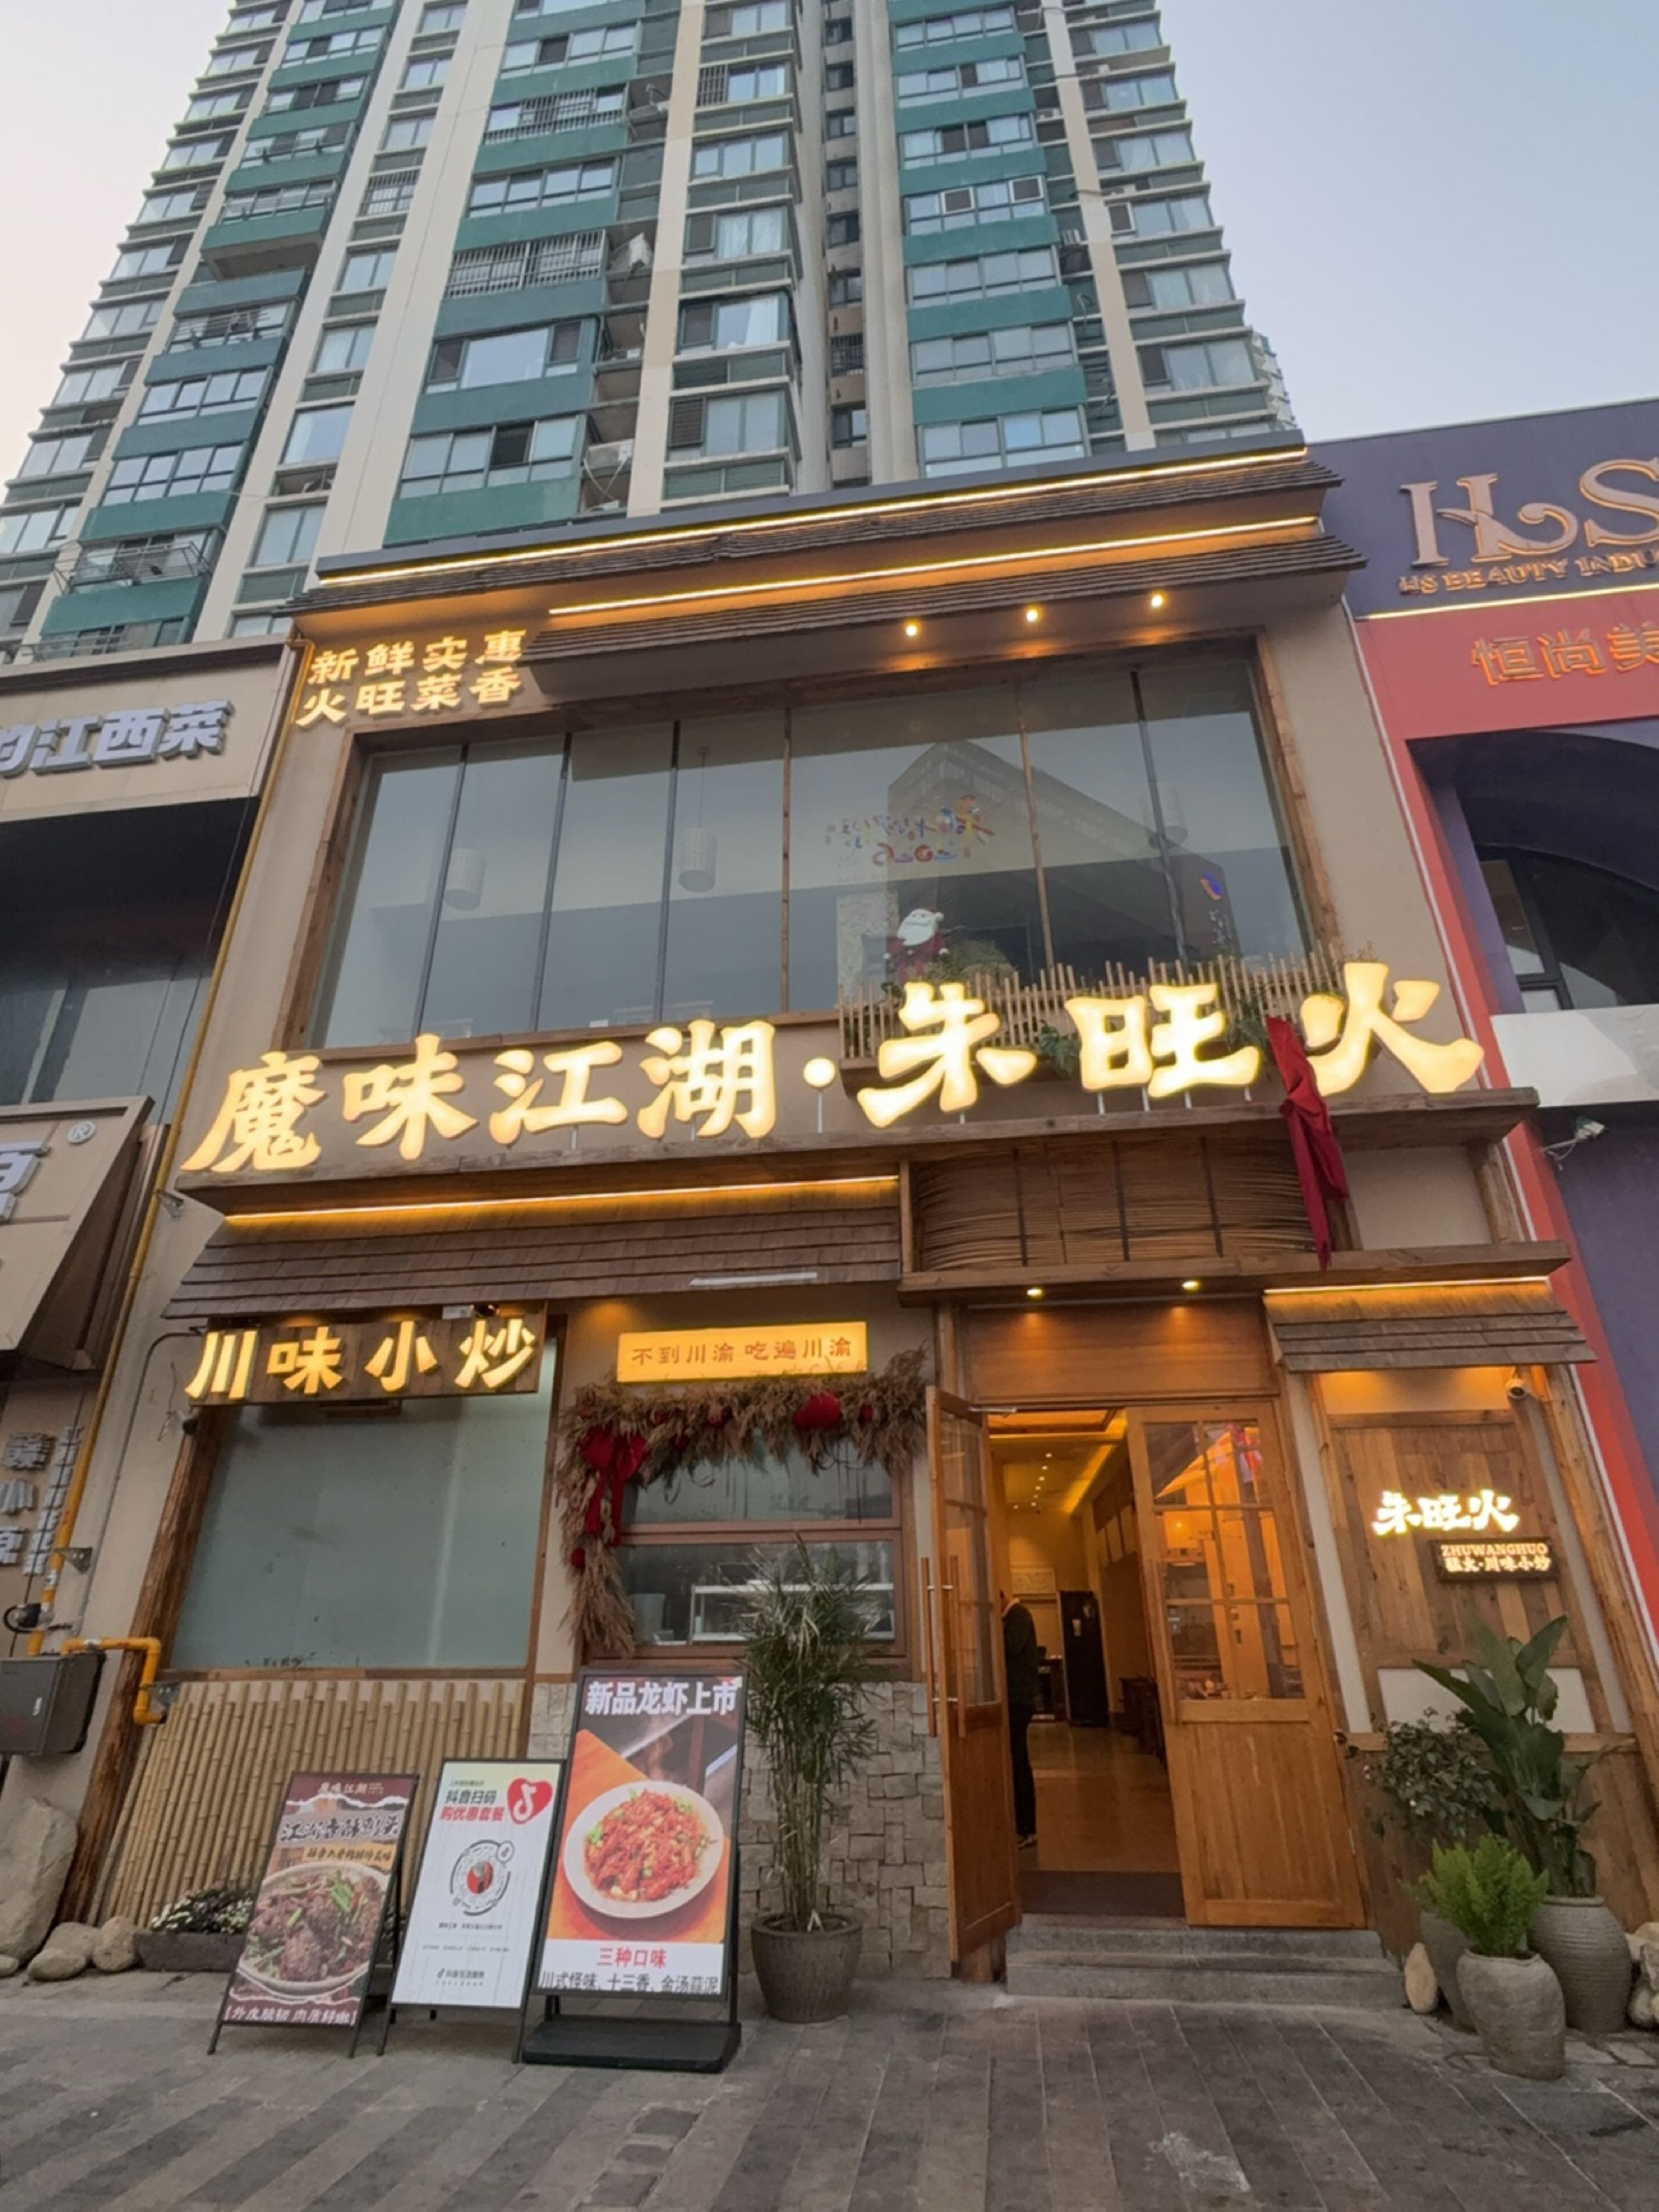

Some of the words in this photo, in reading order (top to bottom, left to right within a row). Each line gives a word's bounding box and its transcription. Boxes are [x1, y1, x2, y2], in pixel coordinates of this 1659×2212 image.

[1442, 557, 1568, 590] BEAUTY
[1575, 549, 1659, 577] INDU
[308, 629, 526, 684] 新鲜实惠
[1471, 621, 1659, 687] 恒尚美
[296, 666, 522, 727] 火旺菜香
[184, 1318, 536, 1400] 川味小炒
[1372, 1489, 1520, 1536] 朱旺火
[1441, 1543, 1548, 1557] ZHUWANGHUO
[585, 1680, 737, 1717] 新品龙虾上市
[596, 1947, 668, 1969] 三种口味
